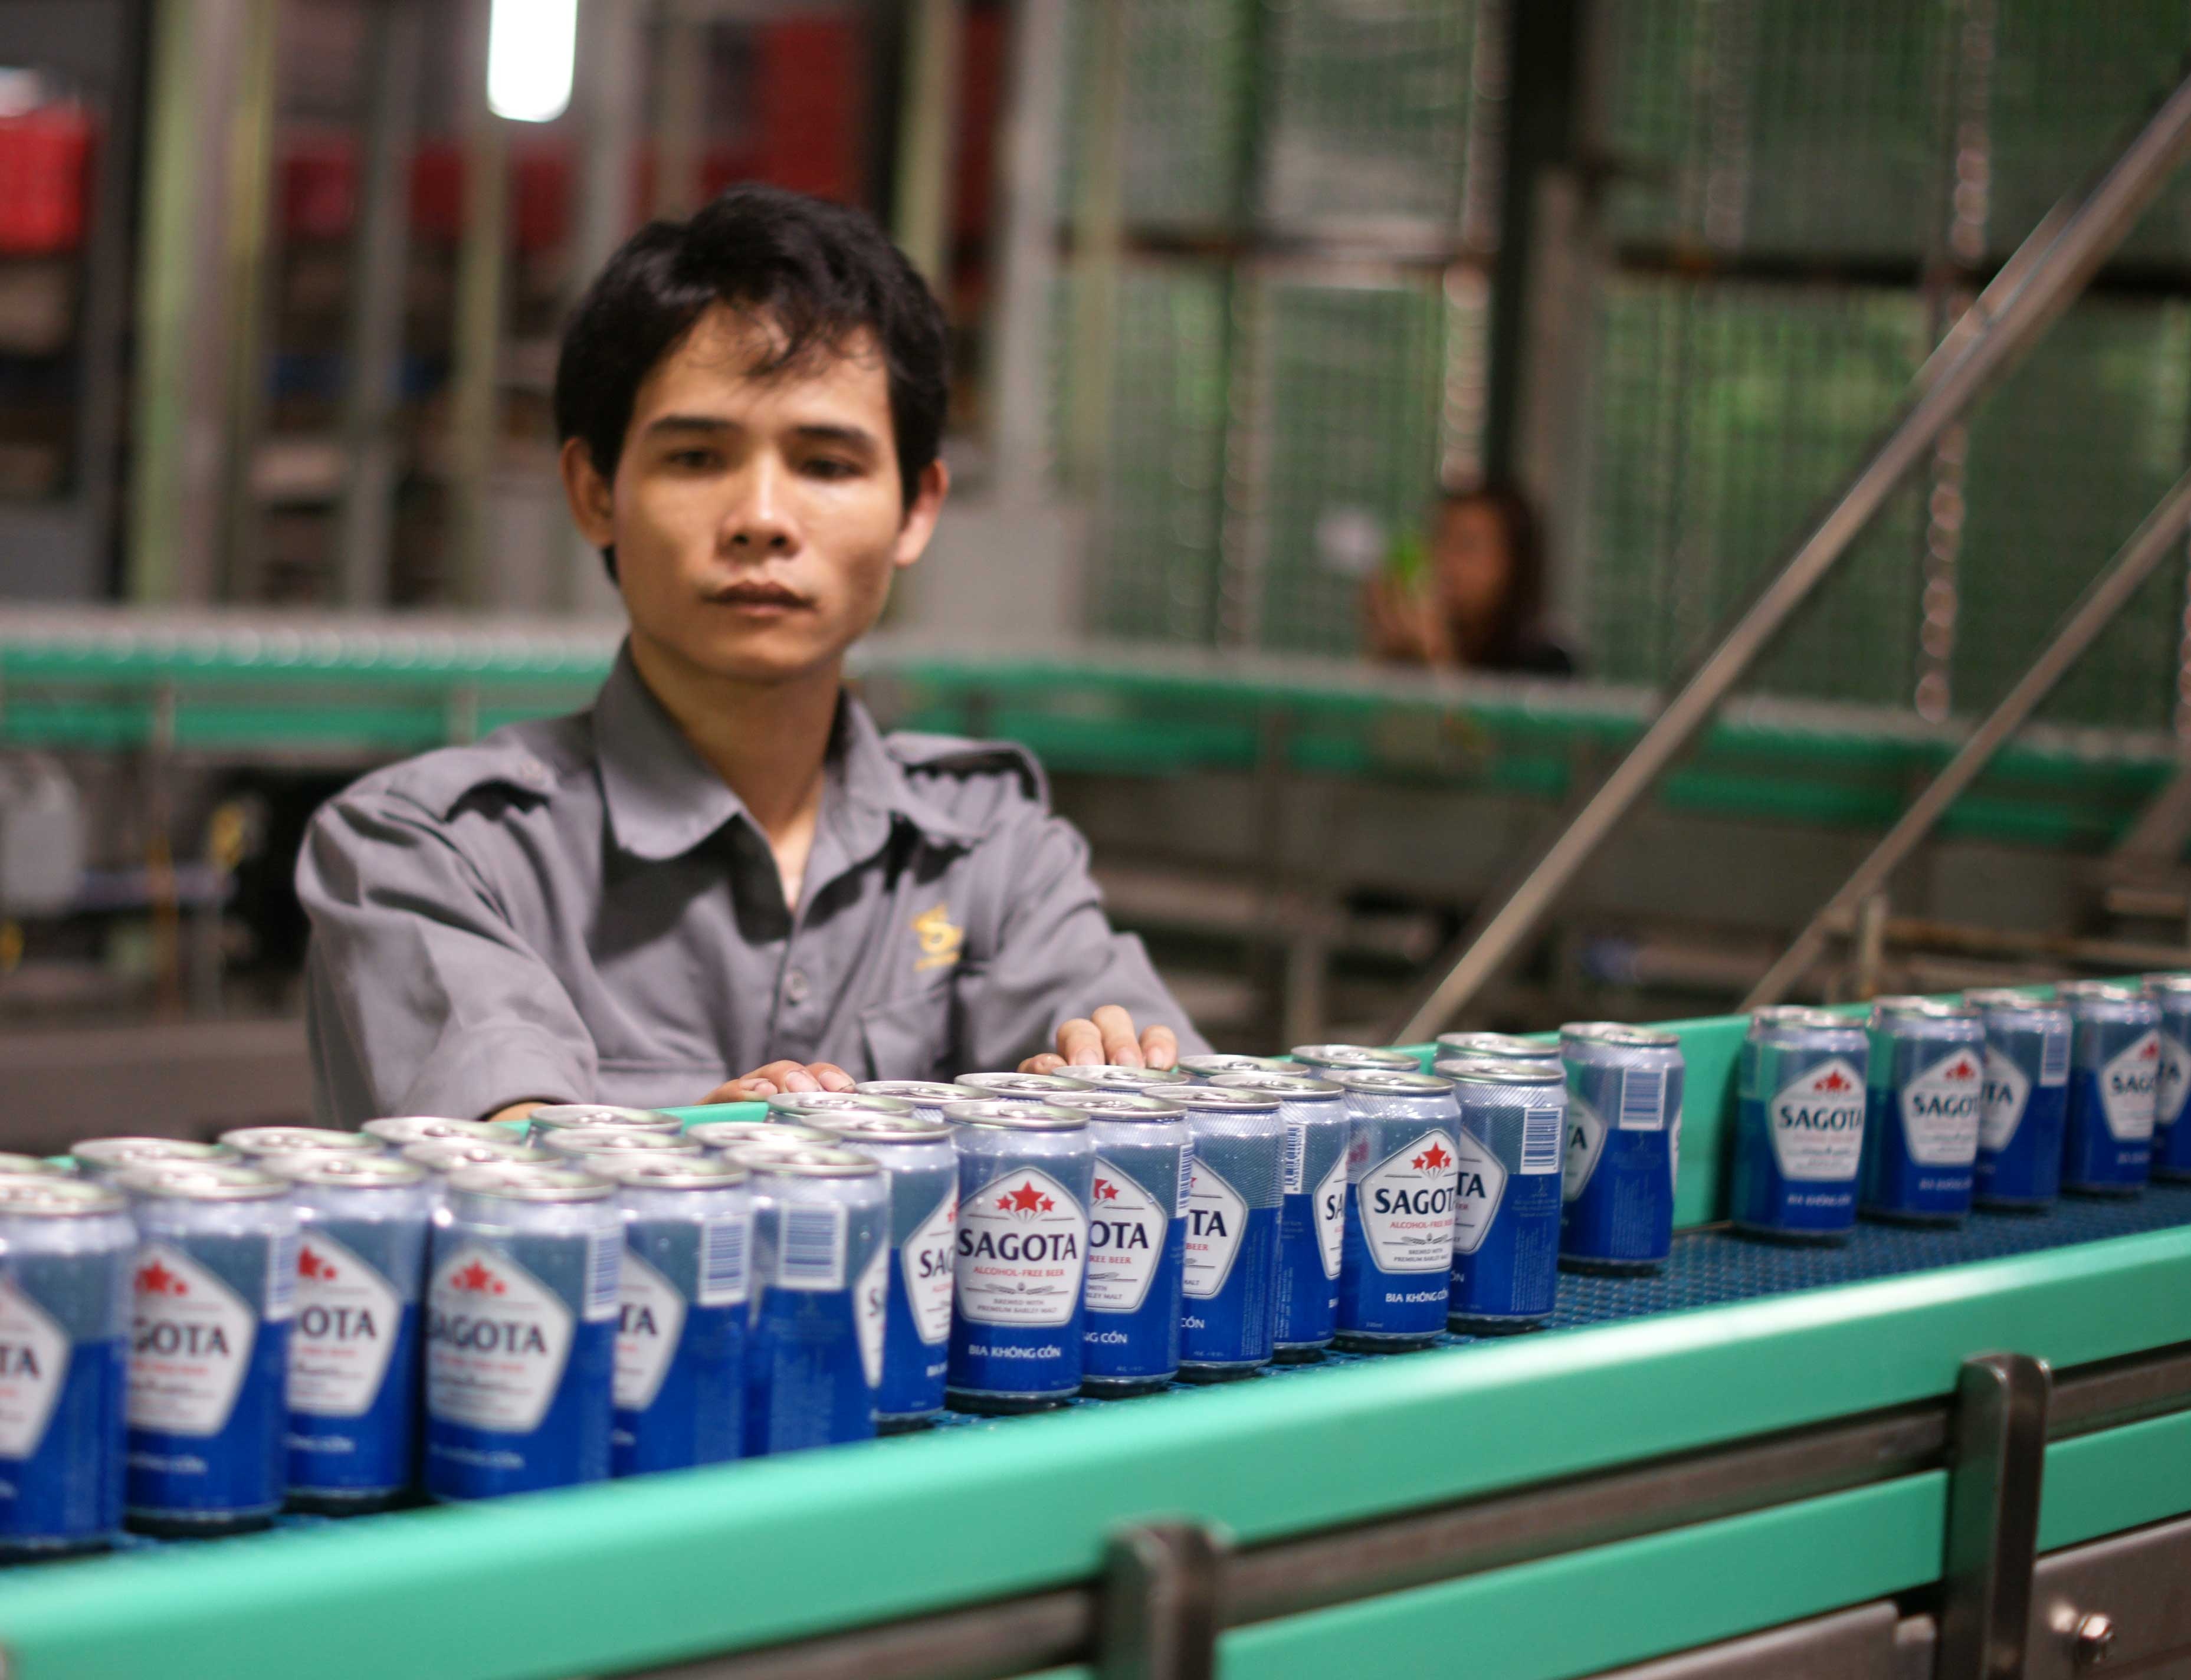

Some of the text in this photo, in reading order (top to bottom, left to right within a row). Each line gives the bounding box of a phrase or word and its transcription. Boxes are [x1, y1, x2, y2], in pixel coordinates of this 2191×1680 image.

[957, 1228, 1078, 1262] SAGOTA
[973, 1266, 1065, 1278] ALCOHOL-FREE BEER
[1385, 1291, 1403, 1303] BIA
[968, 1344, 988, 1356] BIA
[990, 1346, 1036, 1359] KHÔNG
